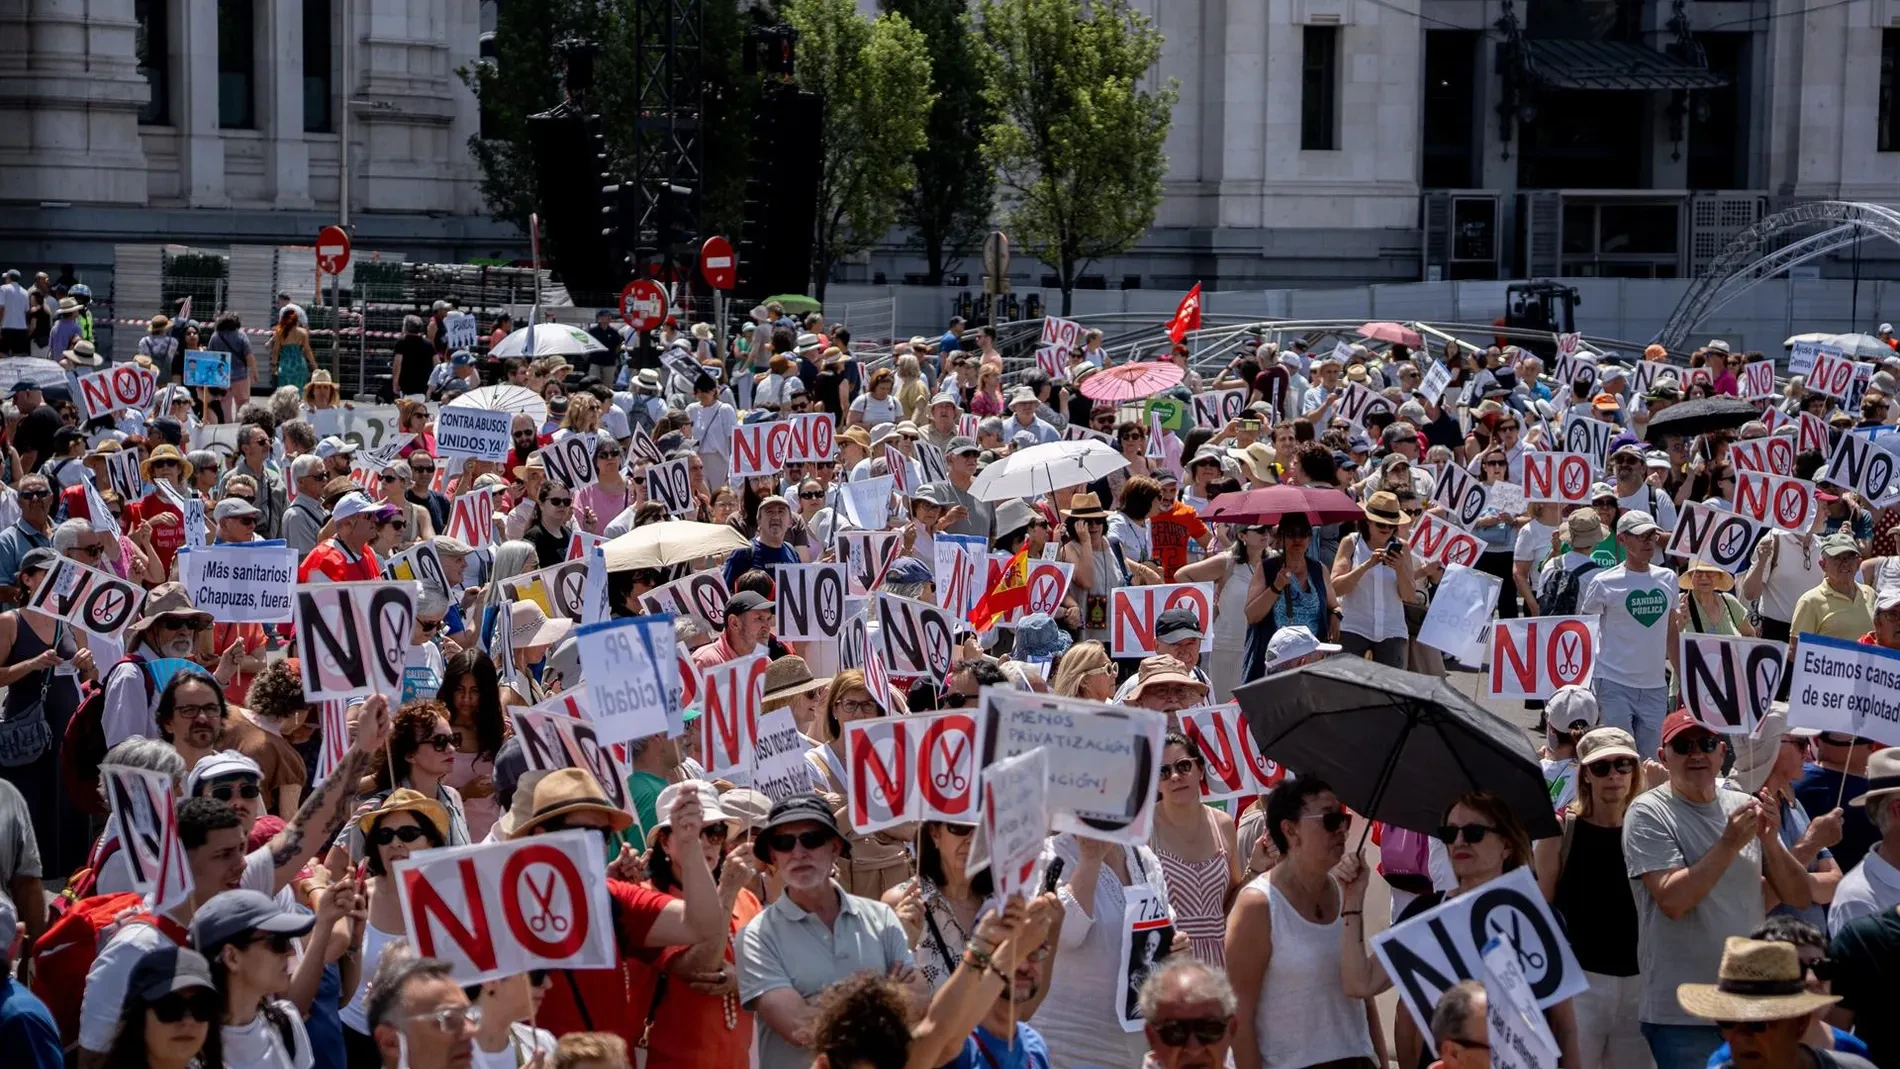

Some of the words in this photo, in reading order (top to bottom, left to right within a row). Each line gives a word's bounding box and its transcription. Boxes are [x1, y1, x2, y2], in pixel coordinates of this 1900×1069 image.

[1043, 322, 1077, 347] NO
[81, 367, 143, 415] NO
[1746, 362, 1773, 399] NO
[1807, 355, 1853, 395] NO
[441, 413, 474, 430] CONTRA
[475, 417, 508, 435] ABUSOS,
[1194, 390, 1246, 429] NO
[438, 433, 488, 453] UNIDOS,
[540, 434, 596, 491] NO
[733, 423, 794, 474] NO
[788, 414, 832, 460] NO
[1730, 437, 1793, 477] NO
[107, 452, 142, 500] NO
[650, 461, 690, 513] NO
[1524, 454, 1591, 500] NO
[1829, 434, 1893, 501] NO
[450, 490, 492, 547] NO
[1435, 464, 1486, 525] NO
[1733, 473, 1809, 529] NO
[1408, 515, 1478, 567] NO
[1670, 503, 1751, 566] NO
[35, 560, 135, 634] NO
[195, 586, 257, 609] ¡Chapuzas,
[261, 590, 292, 608] fuera!
[202, 561, 230, 582] ¡Más
[232, 564, 292, 583] sanitarios!
[779, 567, 843, 637] NO
[1114, 586, 1209, 653] NO
[1631, 597, 1663, 606] SANIDAD
[301, 586, 413, 694] NO
[880, 595, 953, 684] NO
[1493, 620, 1592, 694] NO
[1804, 651, 1862, 680] Estamos
[1685, 639, 1783, 726] NO
[1802, 684, 1819, 706] de
[1822, 691, 1845, 709] ser
[705, 657, 768, 774] NO
[1011, 711, 1075, 728] MENOS
[515, 713, 625, 810] NO
[850, 715, 976, 827] NO
[403, 844, 589, 972] NO
[1381, 887, 1563, 1034] NO
